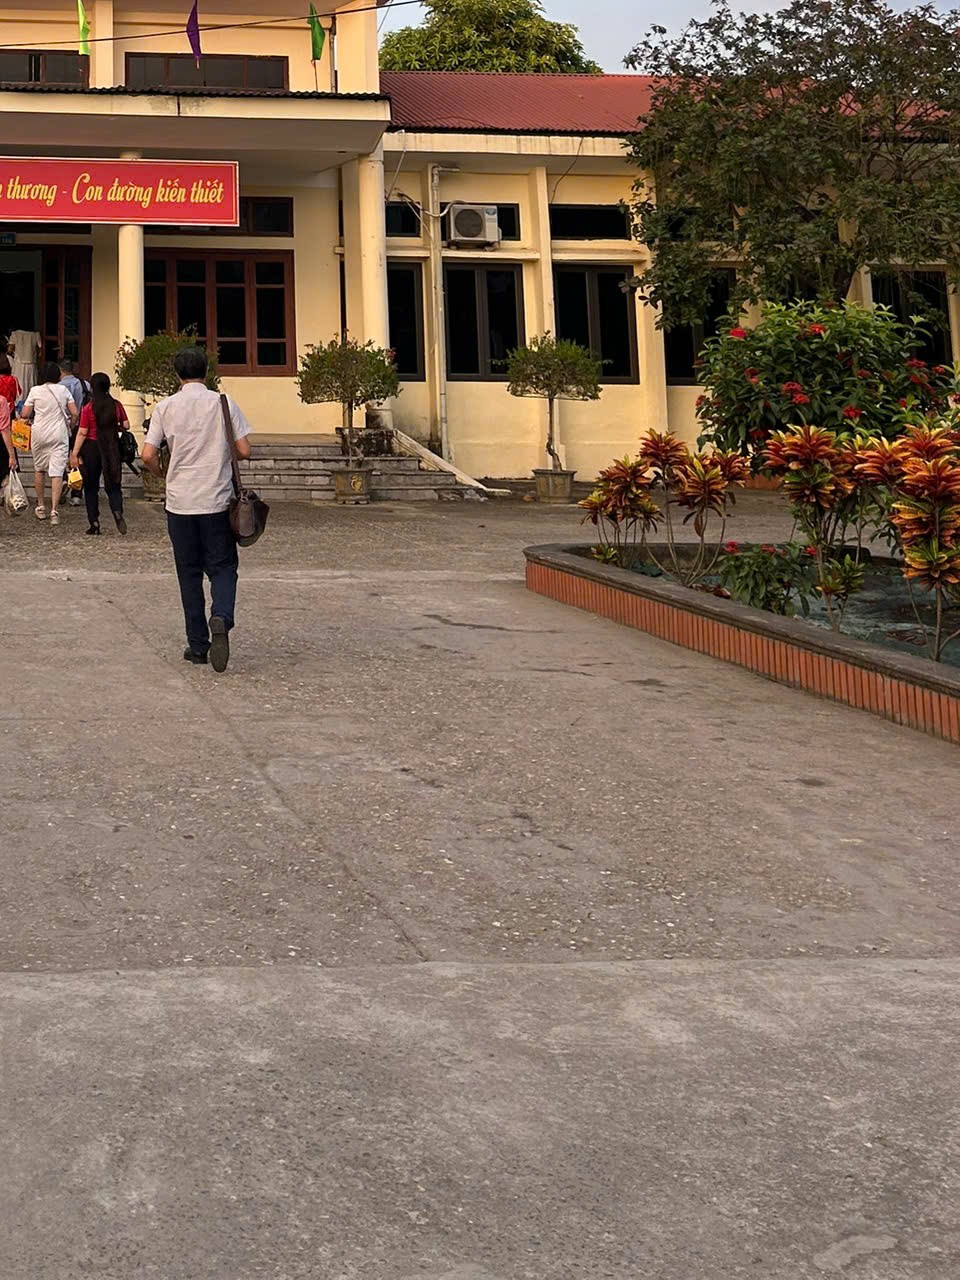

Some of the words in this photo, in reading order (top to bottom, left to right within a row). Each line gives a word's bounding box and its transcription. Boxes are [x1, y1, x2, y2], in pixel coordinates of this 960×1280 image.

[7, 175, 58, 207] thương
[72, 172, 103, 204] Con
[107, 178, 153, 208] đường
[155, 178, 187, 202] kiến
[190, 179, 224, 203] thiết
